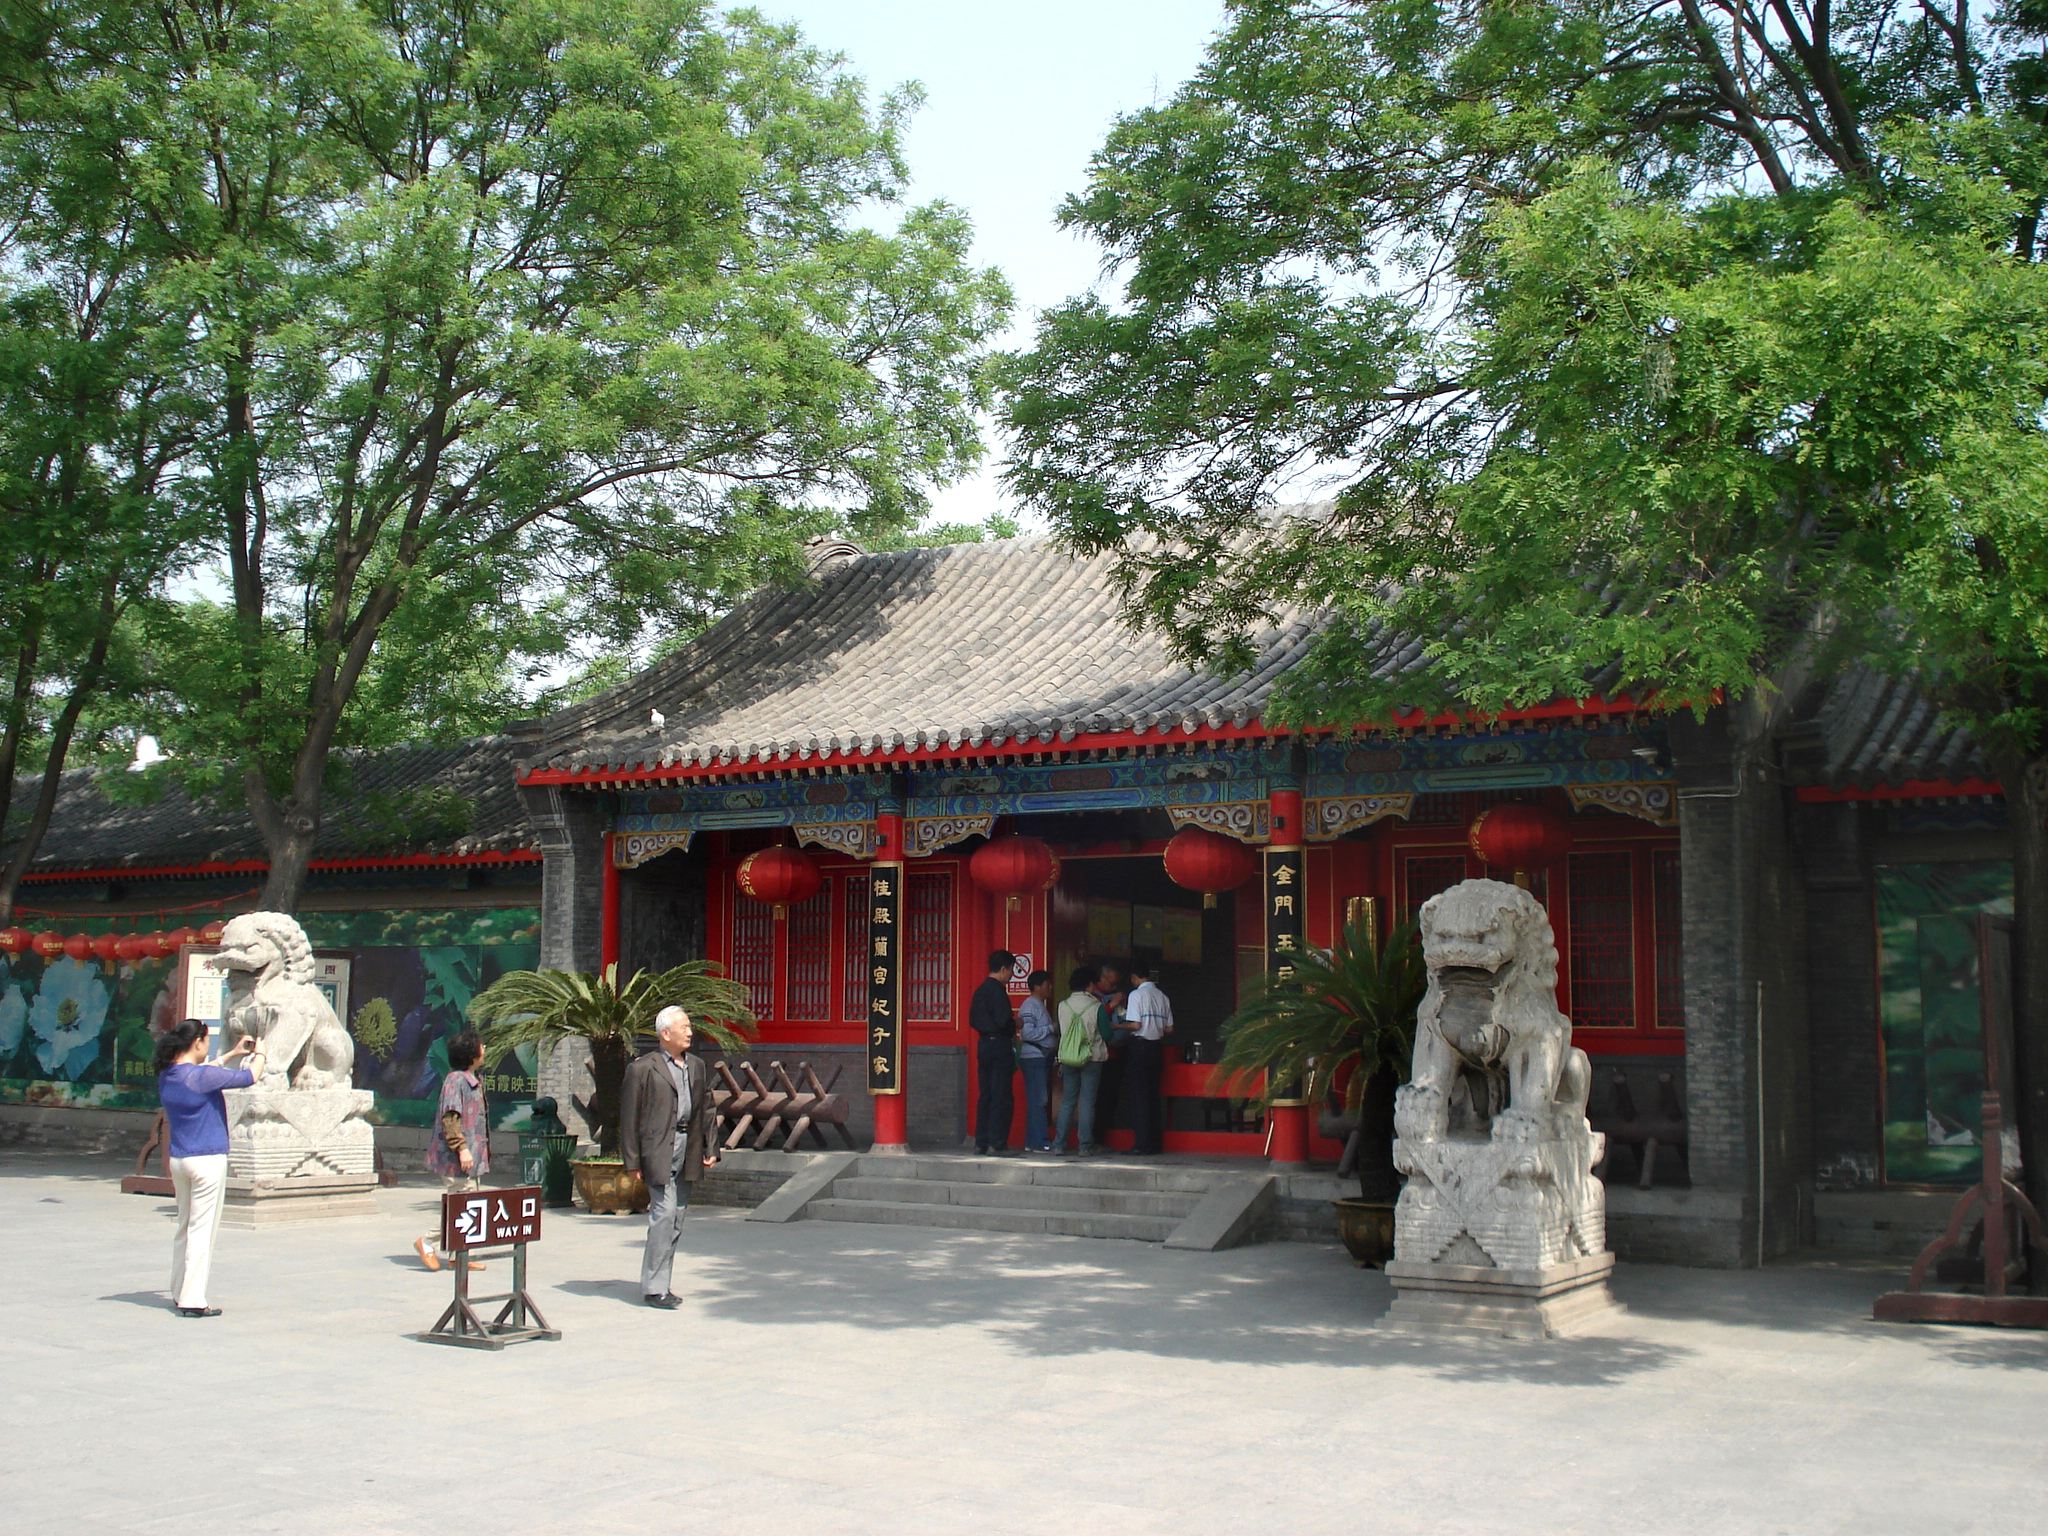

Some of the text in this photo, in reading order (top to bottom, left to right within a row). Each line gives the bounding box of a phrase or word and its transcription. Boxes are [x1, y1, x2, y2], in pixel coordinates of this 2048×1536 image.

[493, 1199, 536, 1222] 入口
[497, 1224, 532, 1239] WAY IN
